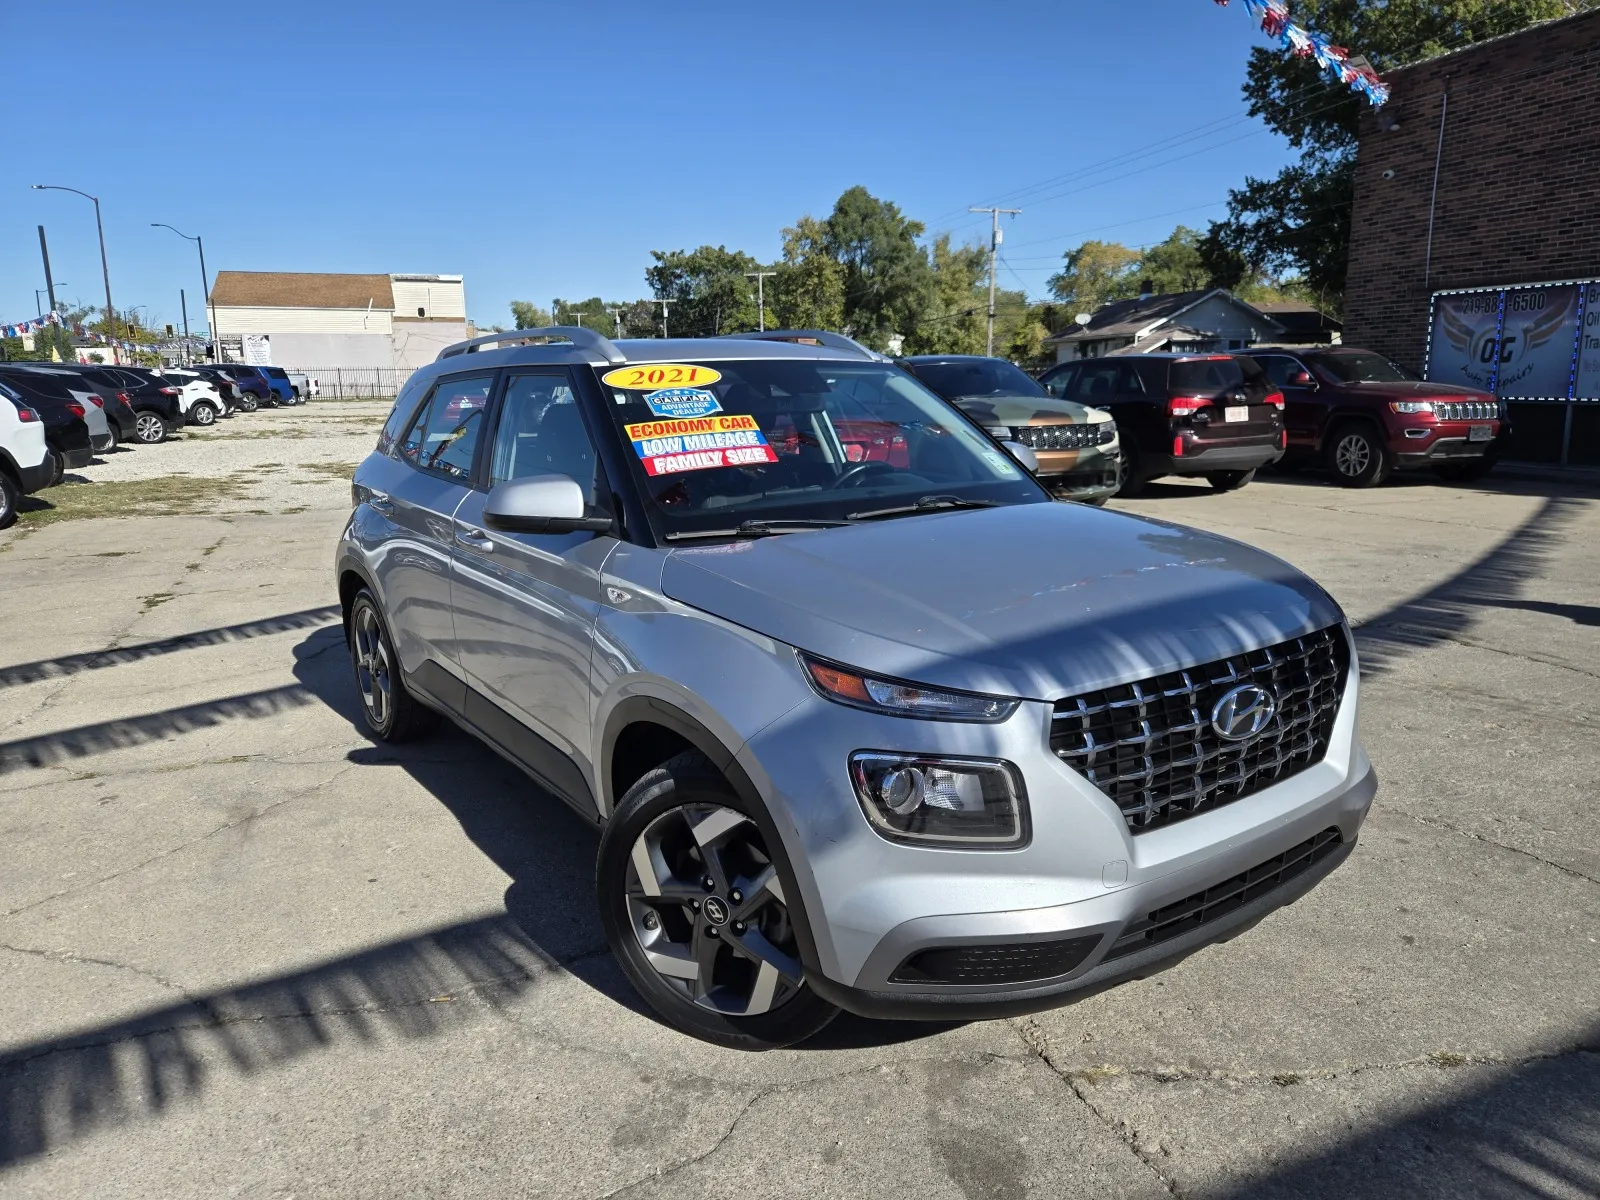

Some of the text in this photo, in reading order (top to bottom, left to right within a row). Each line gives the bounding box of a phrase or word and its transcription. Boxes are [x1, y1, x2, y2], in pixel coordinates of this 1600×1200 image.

[1463, 293, 1545, 314] 219-88-6500
[628, 368, 698, 386] 2021
[1461, 364, 1482, 385] Auto
[651, 394, 711, 405] CARFAX
[661, 402, 710, 411] ADVANTAGE
[673, 407, 705, 416] DEALER
[630, 417, 753, 439] ECONOMY CAR
[641, 431, 760, 456] LOW MILEAGE
[652, 447, 769, 474] FAMILY SIZE
